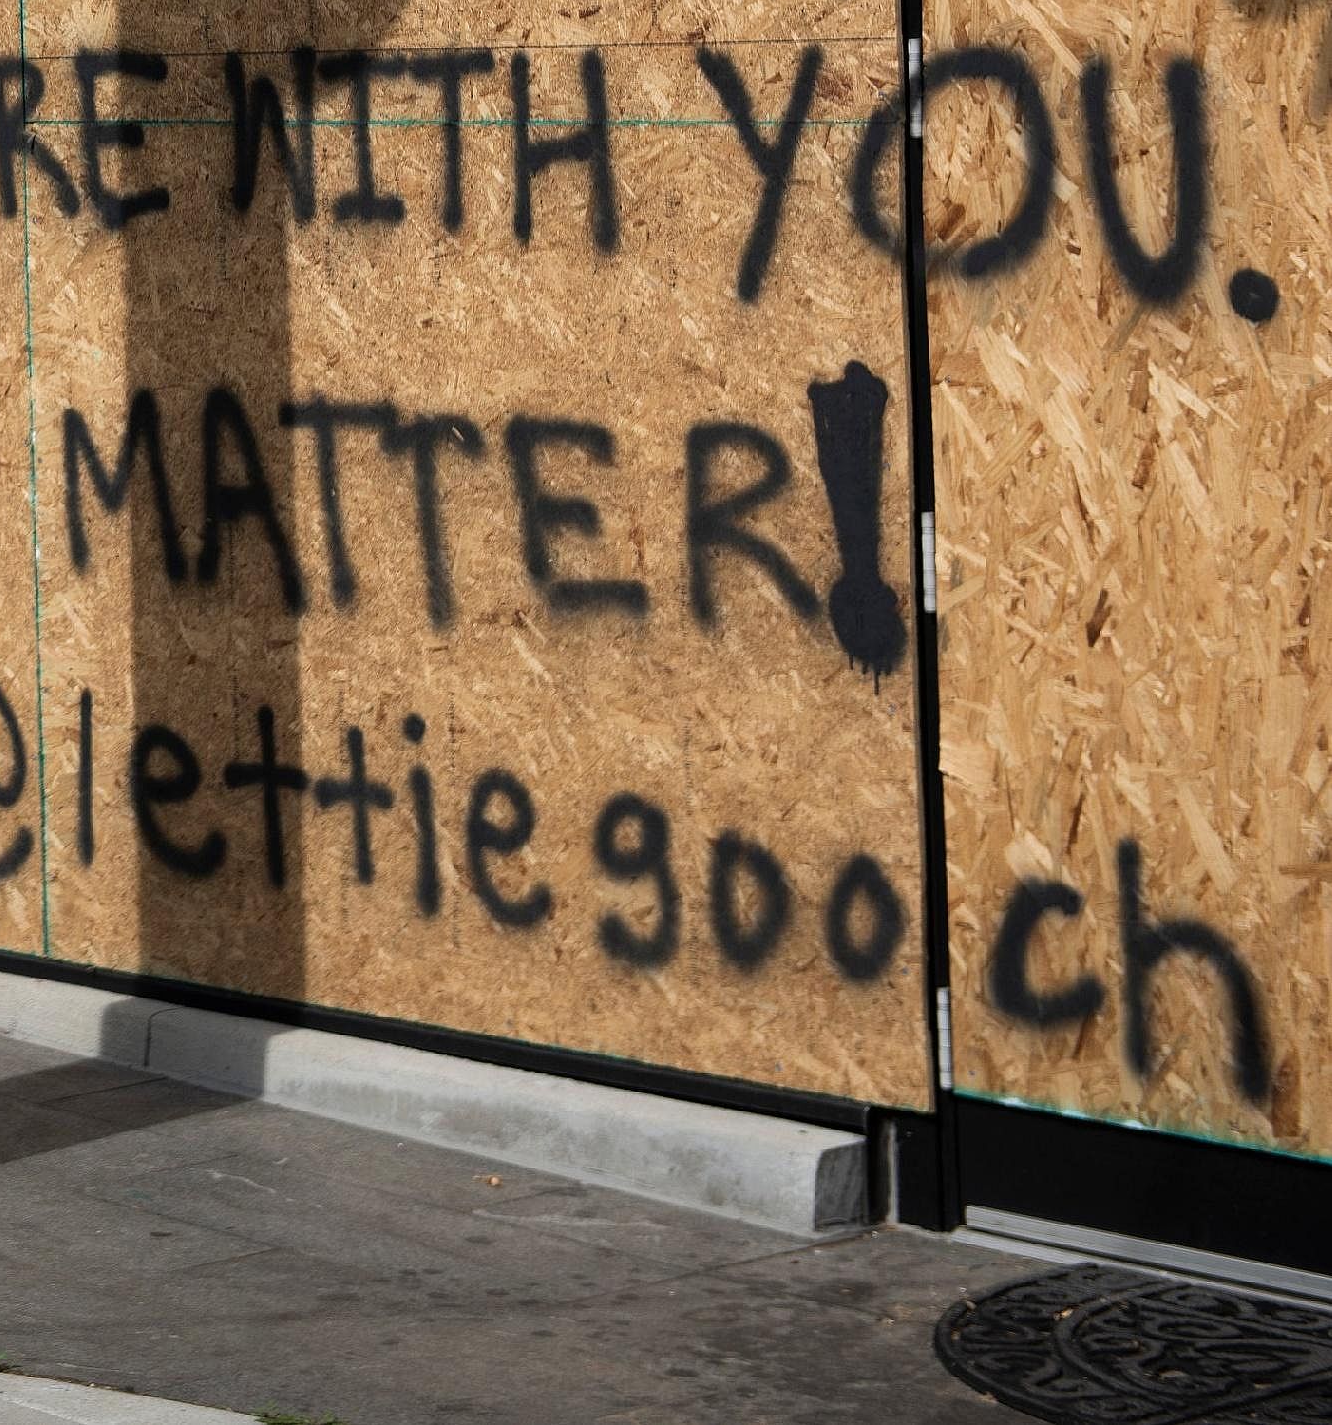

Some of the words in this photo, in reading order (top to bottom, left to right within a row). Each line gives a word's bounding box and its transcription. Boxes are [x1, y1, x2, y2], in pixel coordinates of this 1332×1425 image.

[225, 43, 619, 253] WITH
[696, 44, 1280, 323] YOU.
[63, 359, 908, 680] MATTER!
